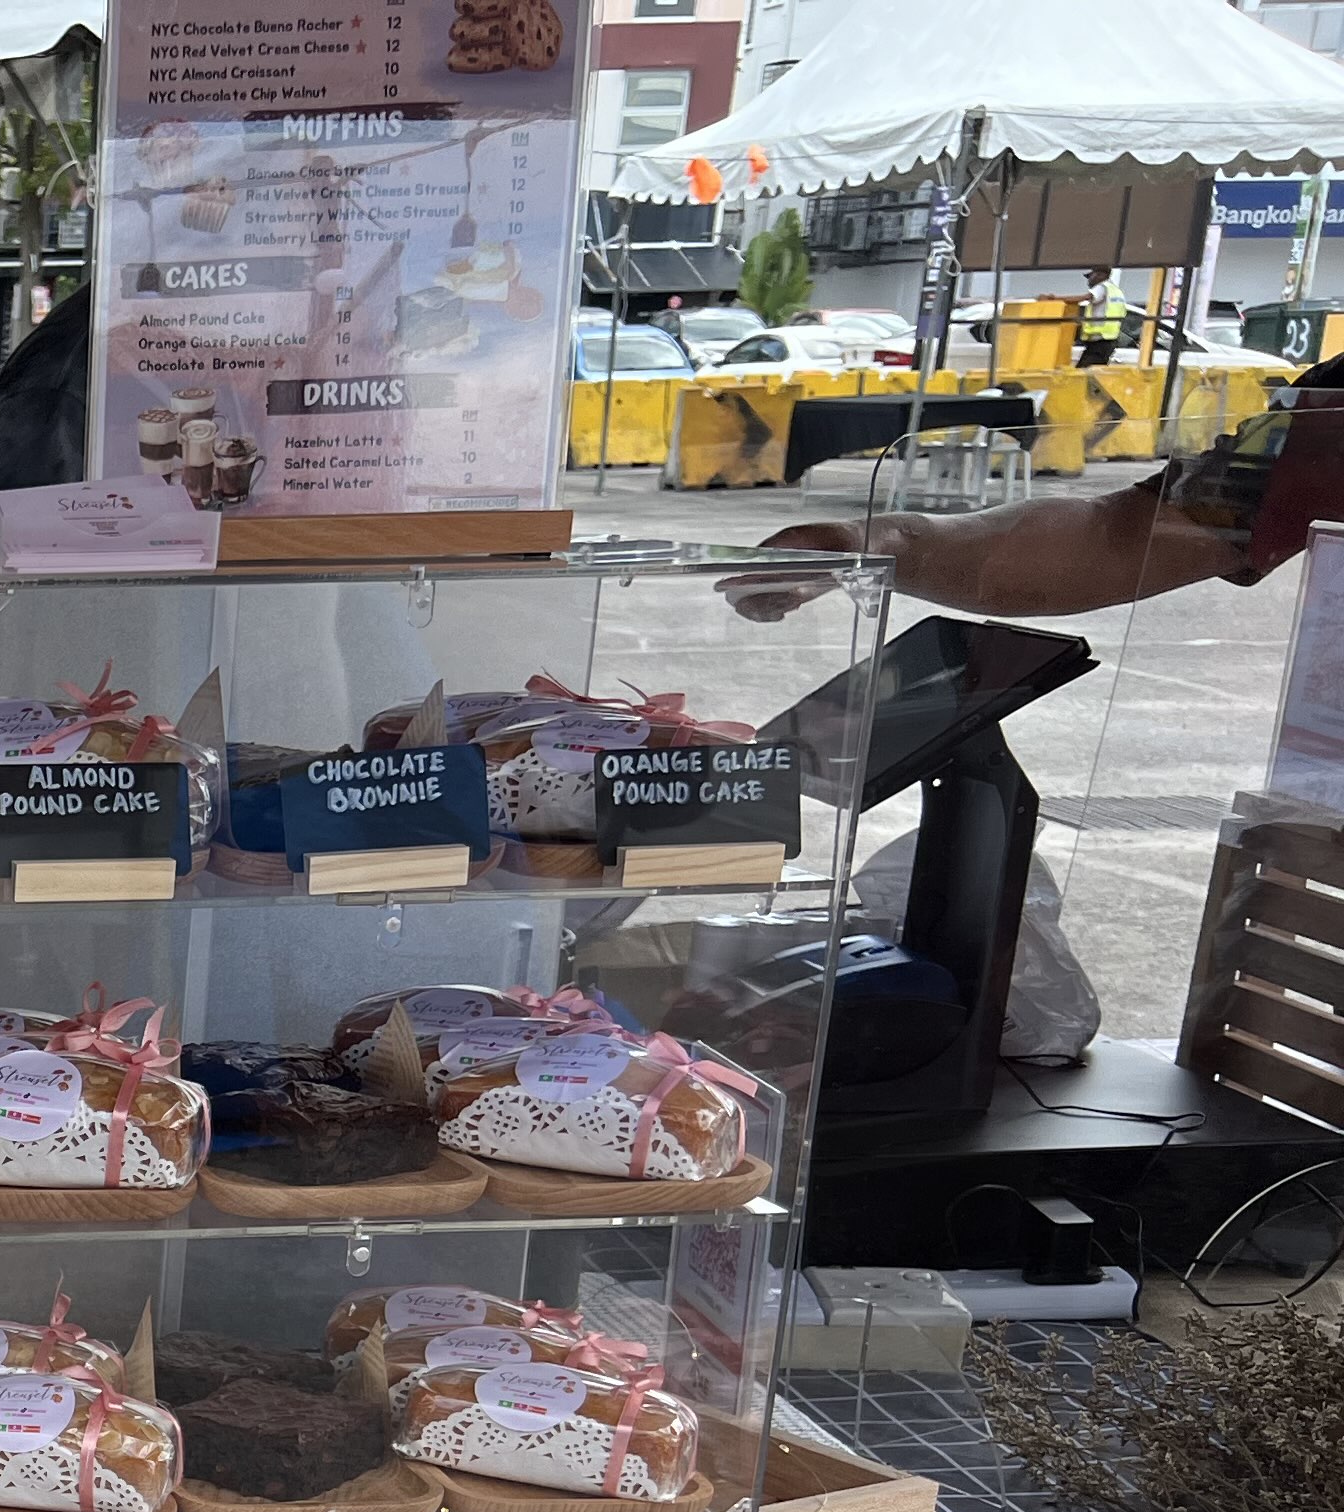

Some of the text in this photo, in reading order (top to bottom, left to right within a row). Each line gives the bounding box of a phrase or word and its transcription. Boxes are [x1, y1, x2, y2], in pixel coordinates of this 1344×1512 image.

[151, 17, 402, 36] NYC Chocolate Bueno Rocher 12
[150, 40, 400, 60] NYC Red Velvet Cream Cheese 12
[149, 63, 400, 82] NYC Almond Croissant 10
[148, 85, 398, 104] NYC Chocolate Chip Walnut 10
[282, 110, 405, 142] MUFFINS
[165, 262, 249, 290] CAKES
[140, 311, 352, 327] Almond Pound Cake 18
[138, 333, 351, 352] Orange Glaze Pound Cake 16
[1282, 318, 1311, 359] 23
[138, 354, 349, 372] Chocolate Brownie 14
[303, 379, 405, 407] DRINKS
[285, 436, 340, 449] Hazelnut
[344, 435, 383, 447] Latte
[284, 457, 326, 470] Salted
[330, 455, 381, 468] Caramel
[384, 455, 424, 467] Latte
[283, 478, 329, 491] Mineral
[333, 478, 373, 489] Water
[307, 751, 446, 782] CHOCOLATE
[601, 748, 791, 778] ORANGE GLAZE
[27, 766, 135, 790] ALMOND
[326, 778, 443, 812] BROWNIE
[612, 777, 766, 806] POUND CAKE
[0, 791, 160, 816] POUND CAKE
